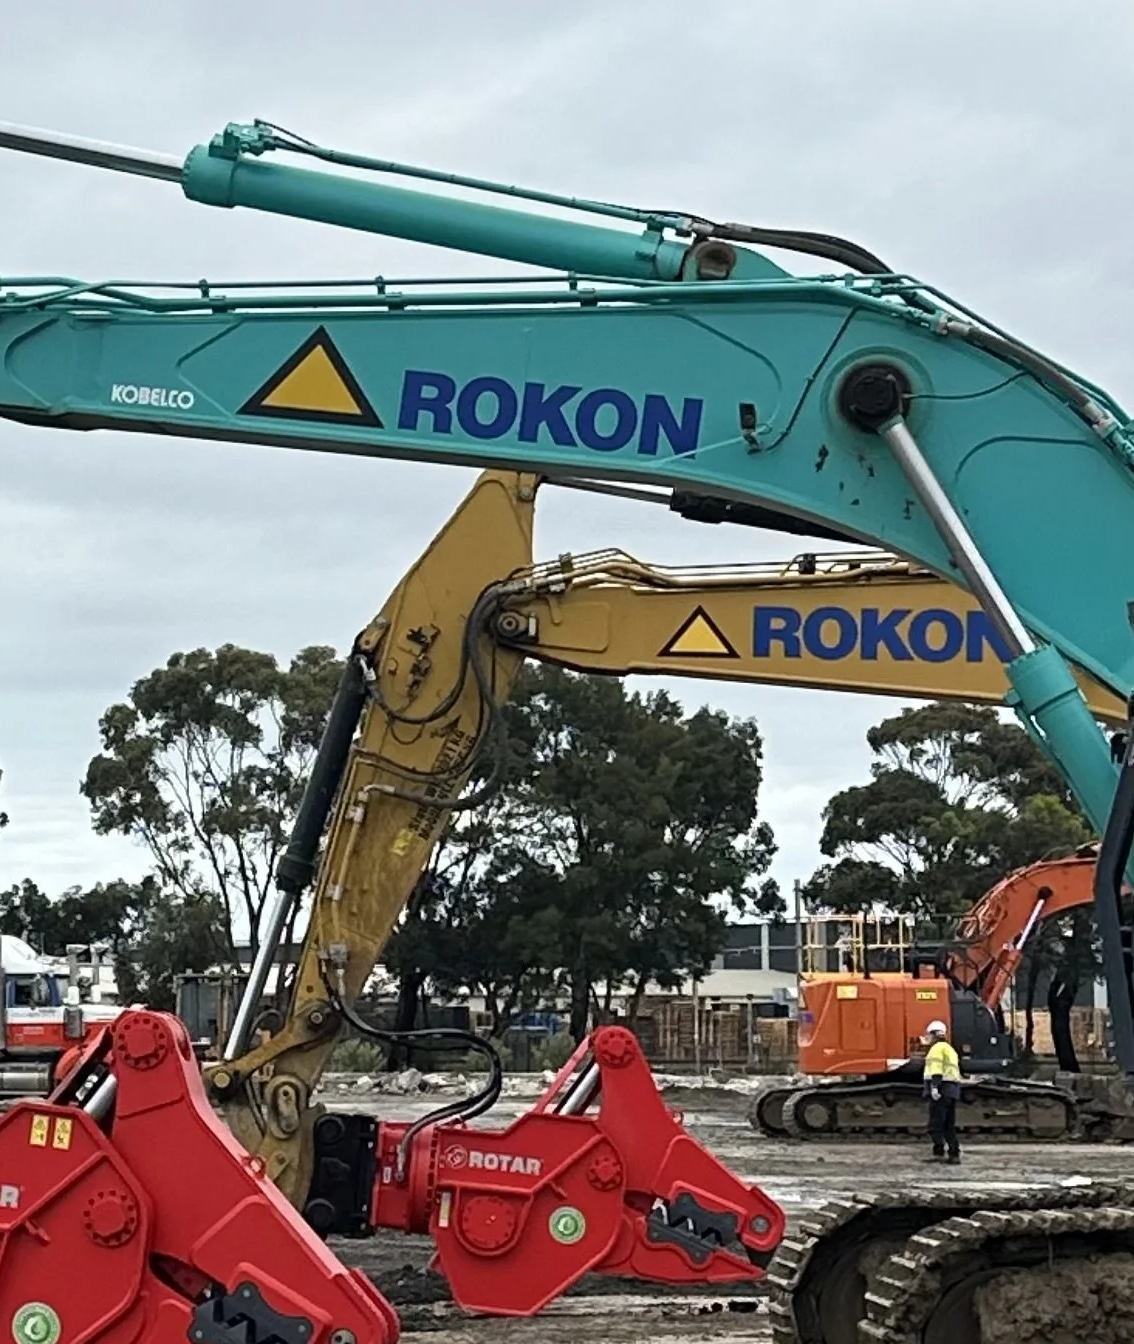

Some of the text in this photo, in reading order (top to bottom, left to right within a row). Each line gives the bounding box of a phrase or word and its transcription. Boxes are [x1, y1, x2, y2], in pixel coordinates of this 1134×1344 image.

[111, 383, 195, 409] KOBELCO
[397, 369, 704, 459] ROKON
[752, 606, 1015, 664] ROKON
[468, 1150, 542, 1176] ROTAR
